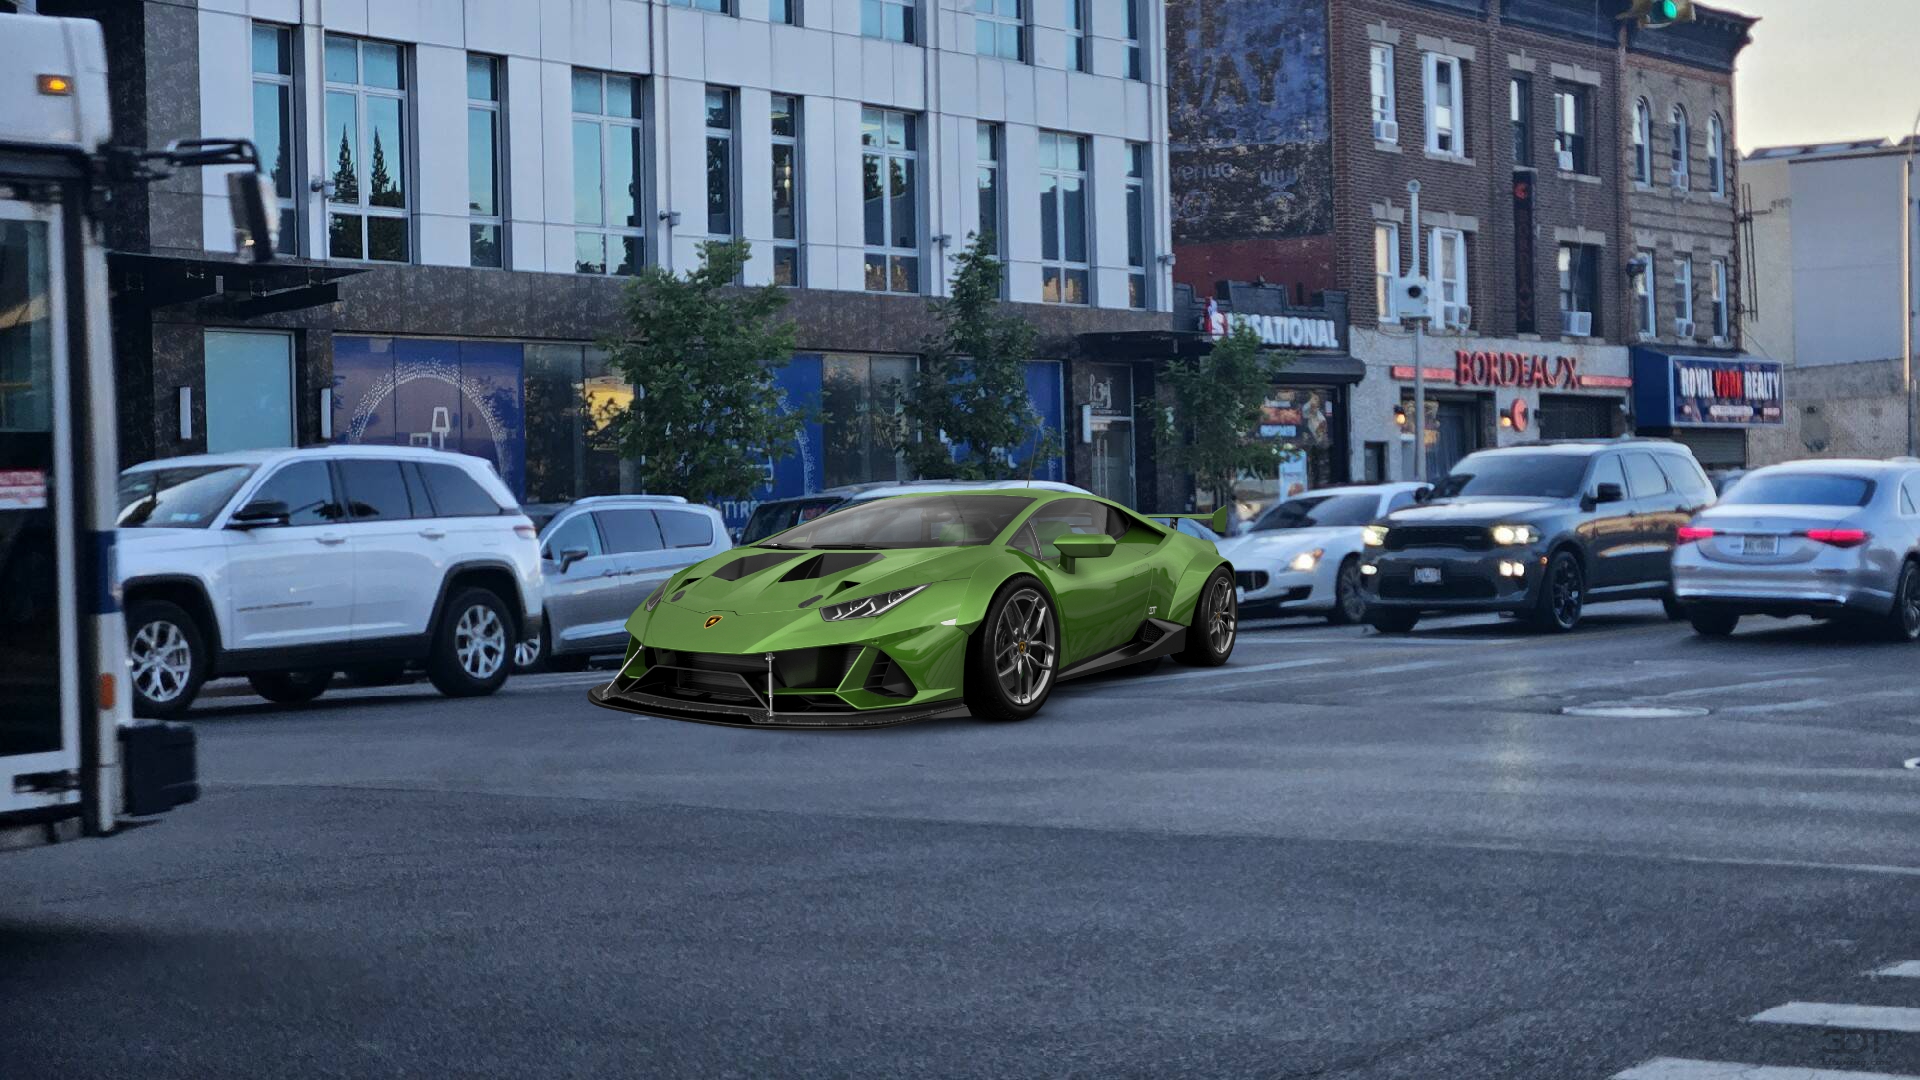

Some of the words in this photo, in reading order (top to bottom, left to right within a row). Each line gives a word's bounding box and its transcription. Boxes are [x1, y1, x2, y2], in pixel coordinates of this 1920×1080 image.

[1456, 350, 1579, 389] BORDEAUX
[1681, 367, 1715, 398] ROYAL
[1744, 371, 1780, 400] REALTY
